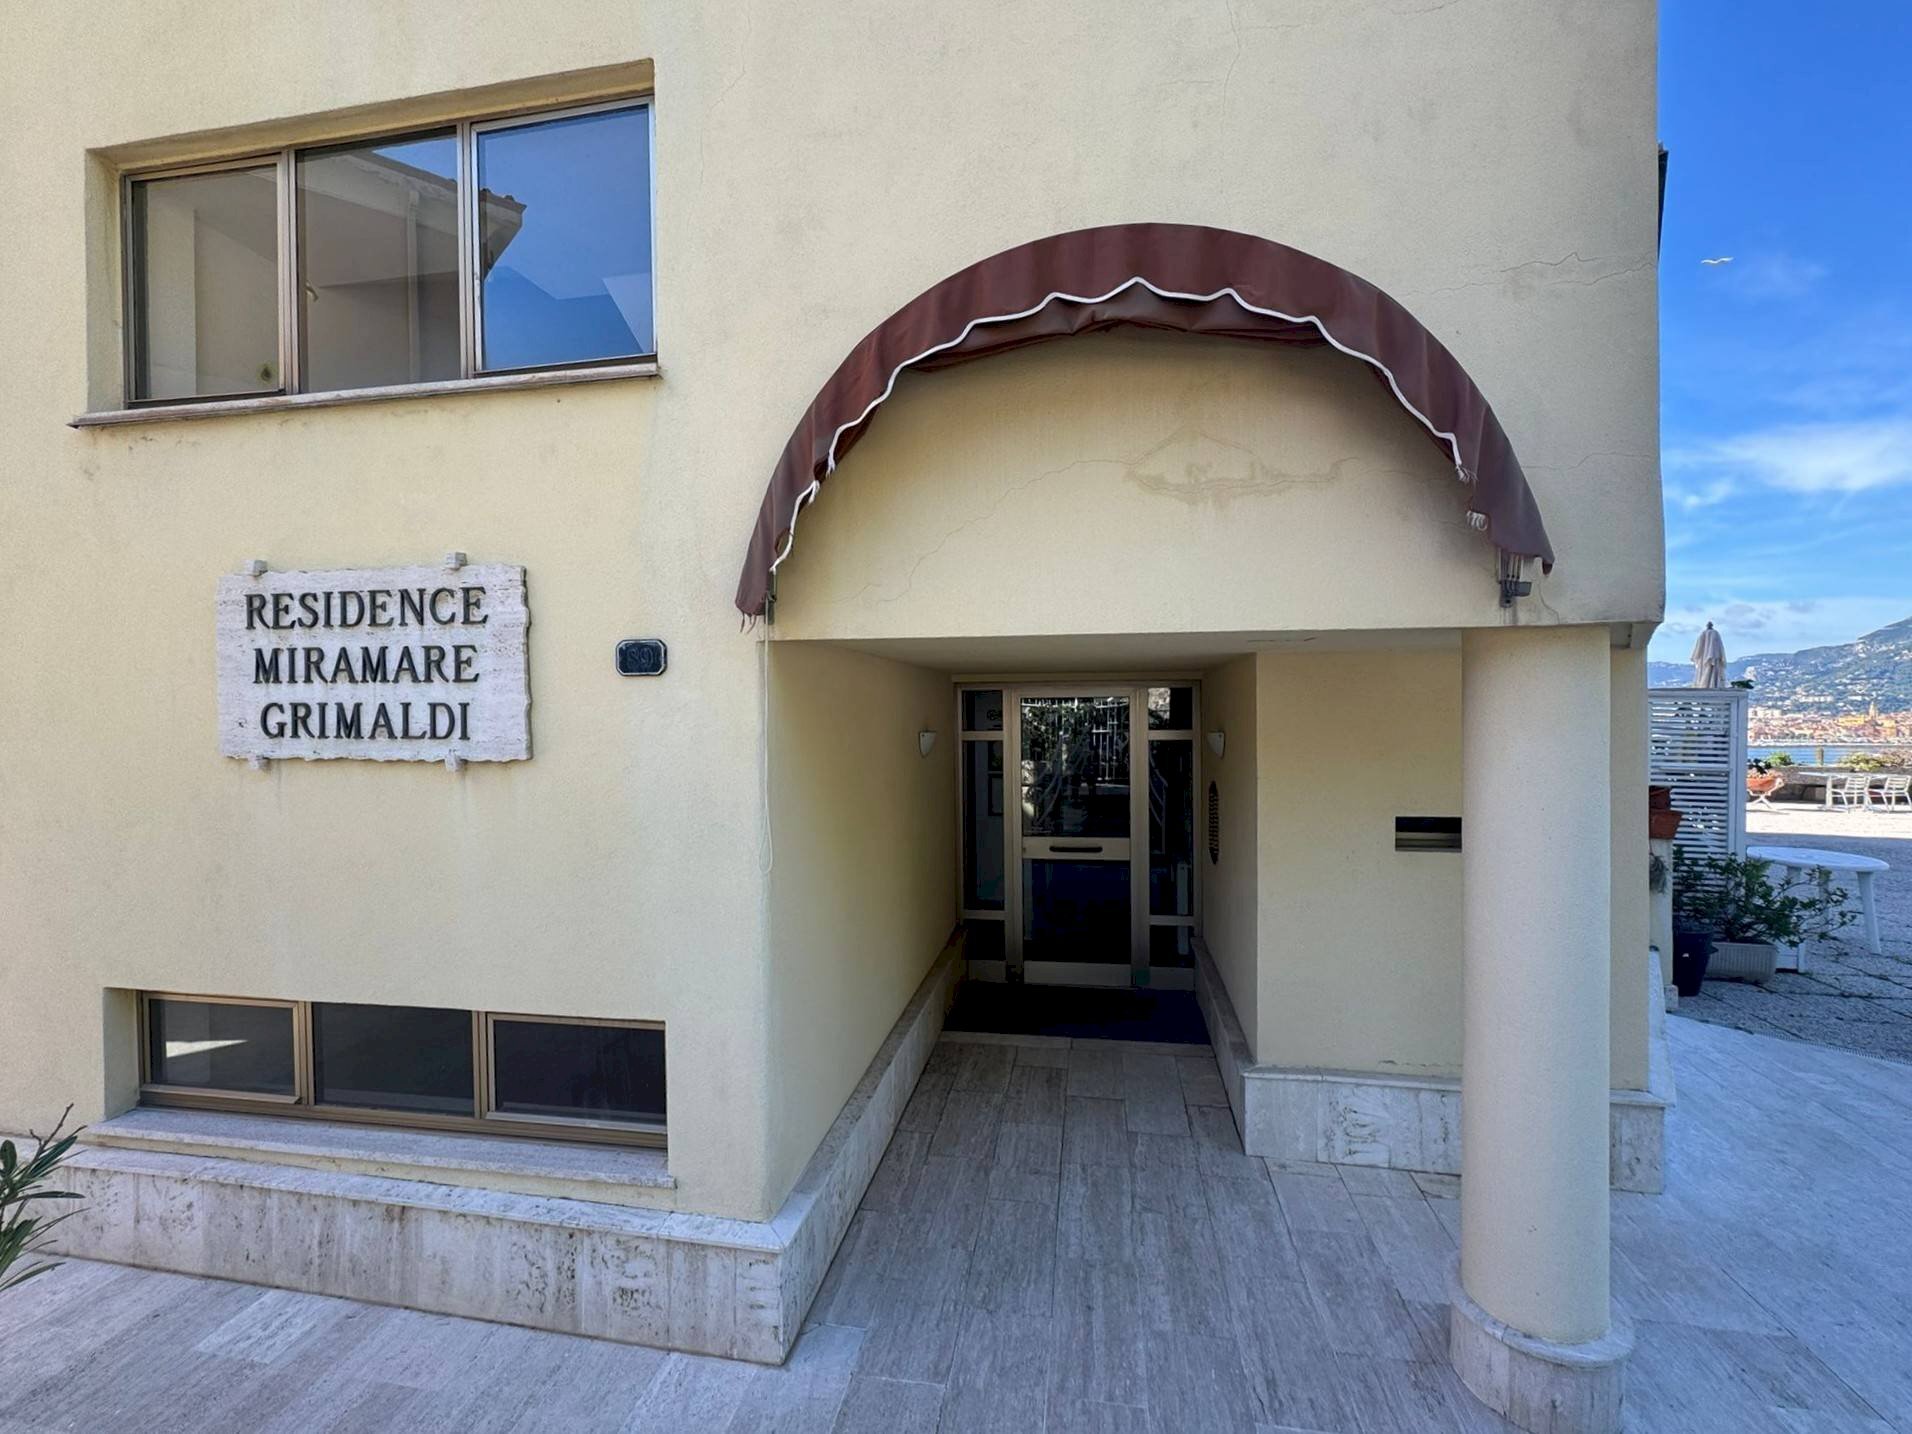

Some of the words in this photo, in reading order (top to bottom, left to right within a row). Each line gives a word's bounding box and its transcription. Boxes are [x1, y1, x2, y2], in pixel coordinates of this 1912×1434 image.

[245, 586, 489, 630] RESIDENCE
[253, 644, 480, 684] MIRAMARE
[260, 702, 471, 741] GRIMALDI
